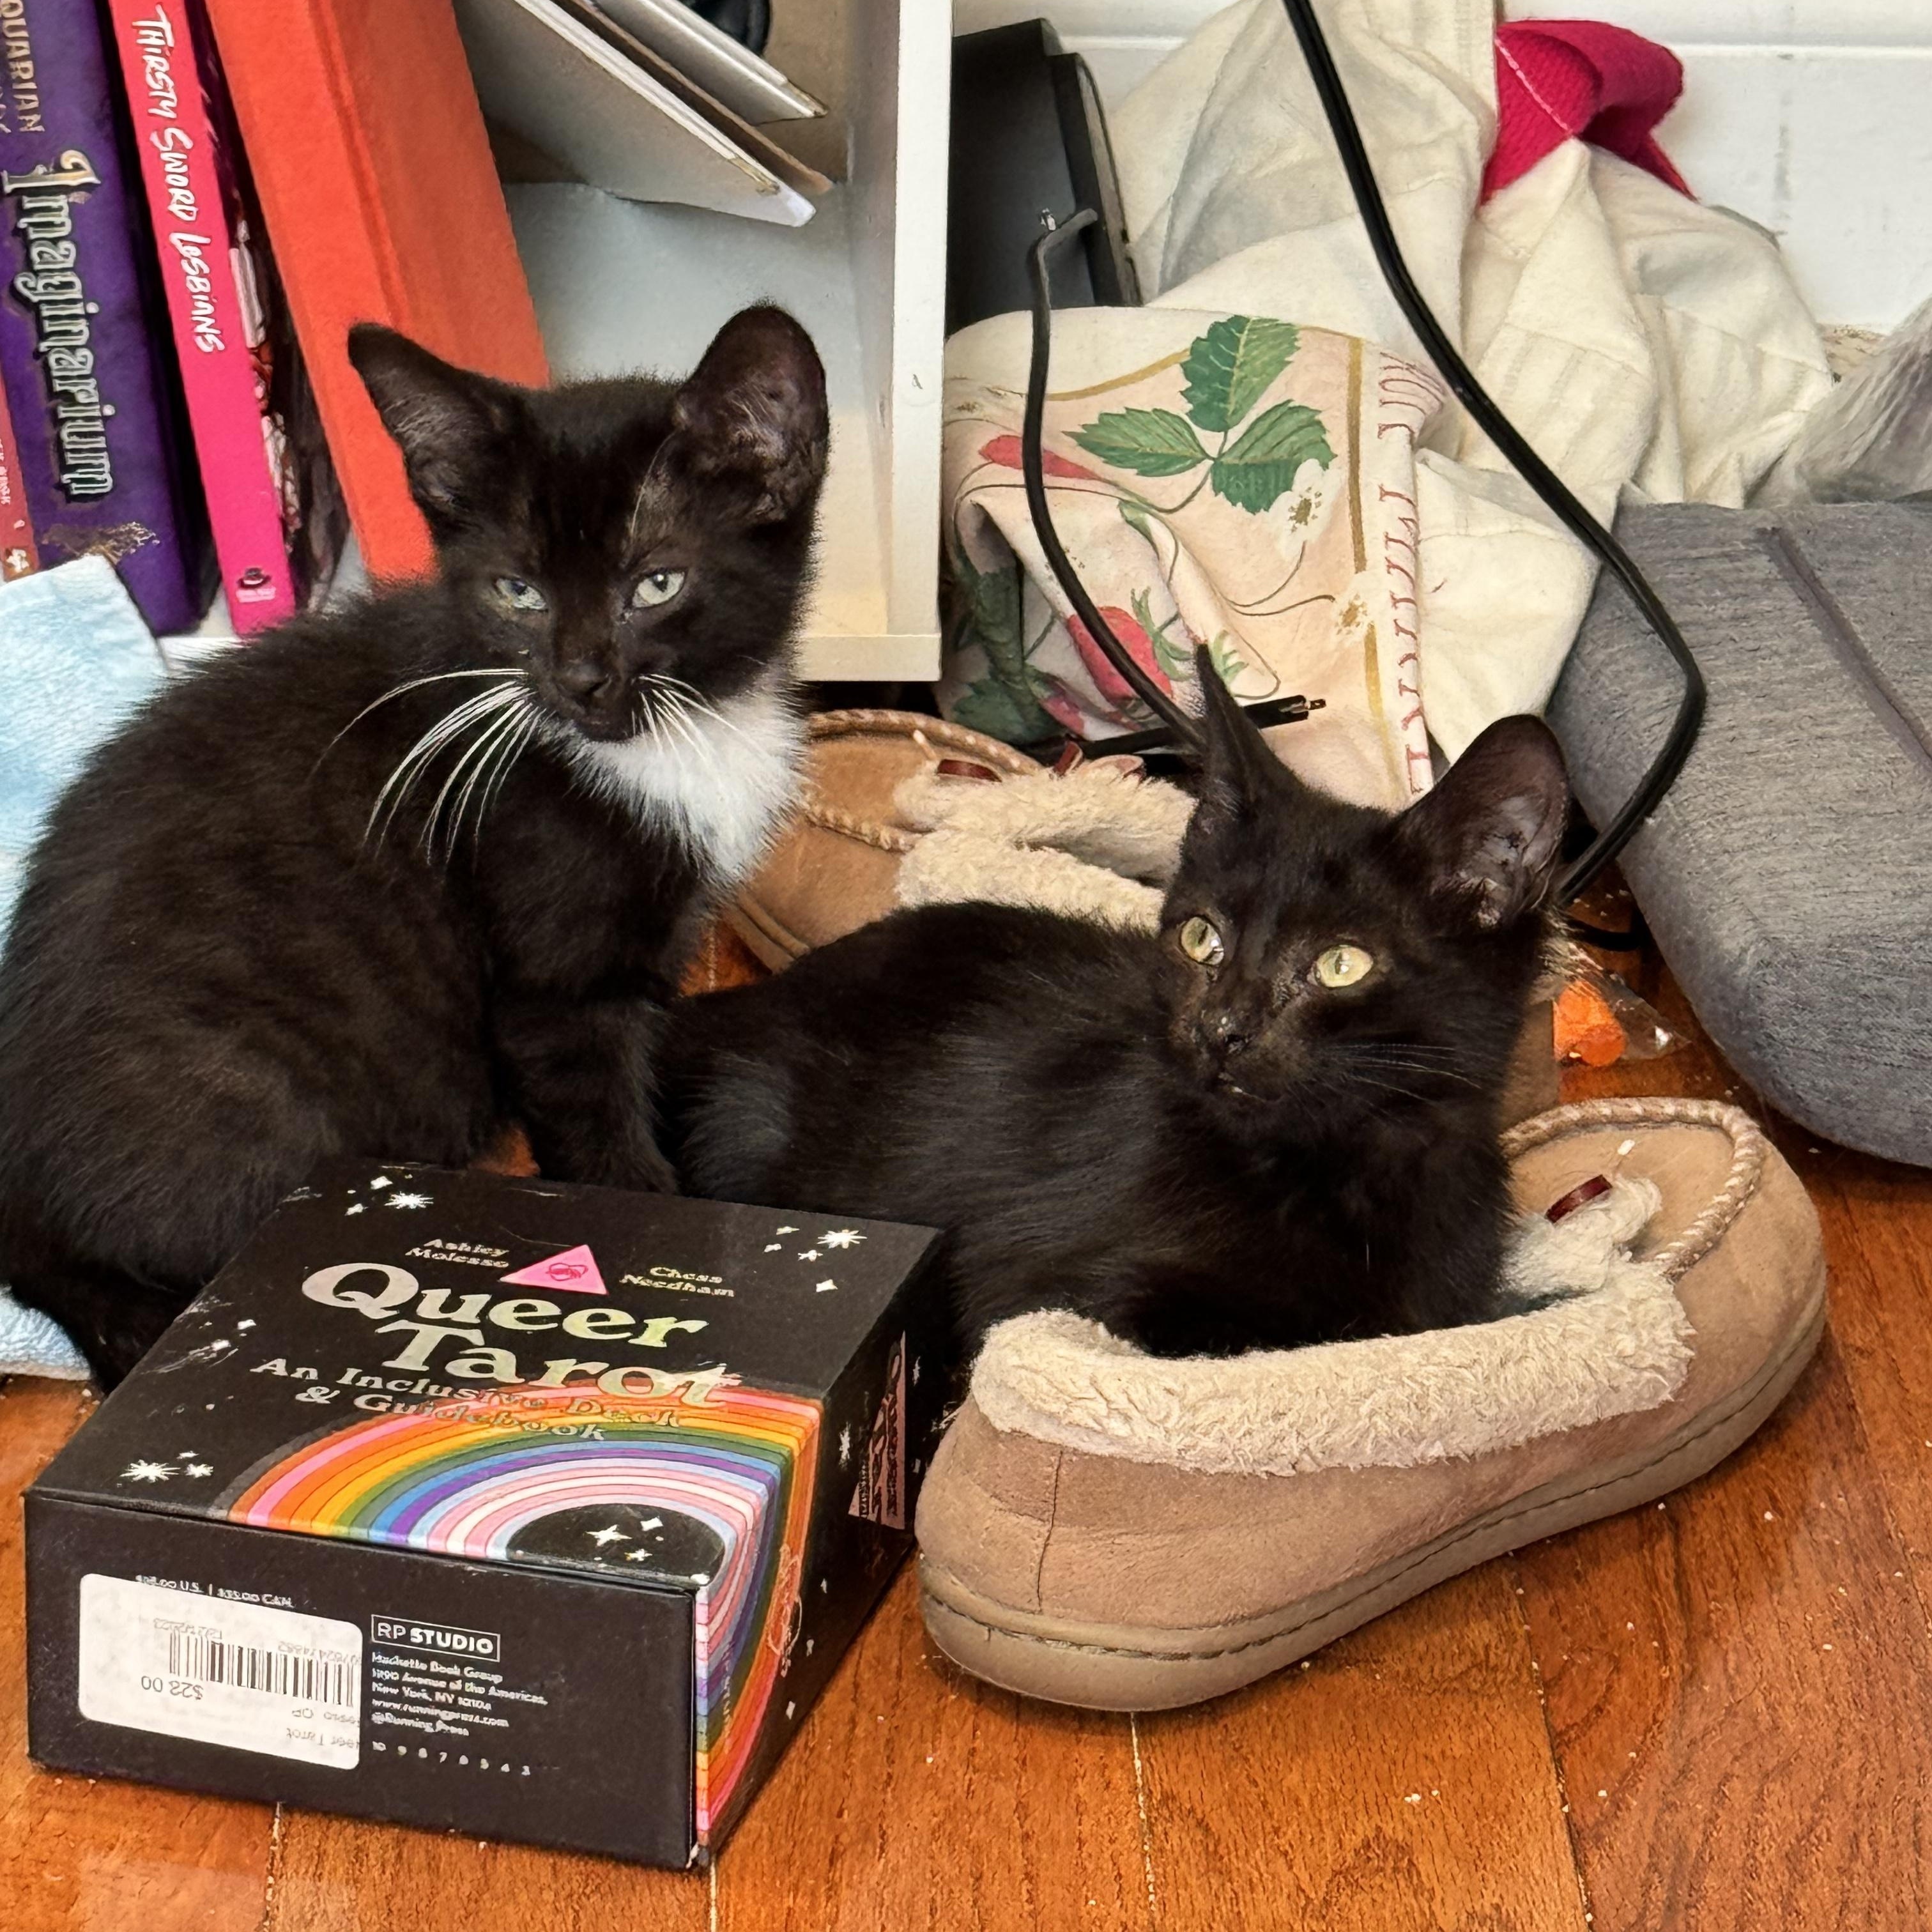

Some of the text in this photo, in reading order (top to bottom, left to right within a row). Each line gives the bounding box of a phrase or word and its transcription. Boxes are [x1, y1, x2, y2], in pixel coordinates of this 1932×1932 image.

[132, 3, 178, 119] THIRSTY
[150, 126, 198, 224] SWORD
[2, 149, 116, 496] Imaginarium
[424, 1238, 510, 1257] Ashley
[301, 1262, 710, 1348] Queer
[249, 1358, 680, 1428] An Inclusive Deck
[374, 1319, 742, 1408] Tarot
[295, 1386, 605, 1441] & Guidebook
[377, 1621, 494, 1655] RP STUDIO
[434, 1691, 456, 1705] NY
